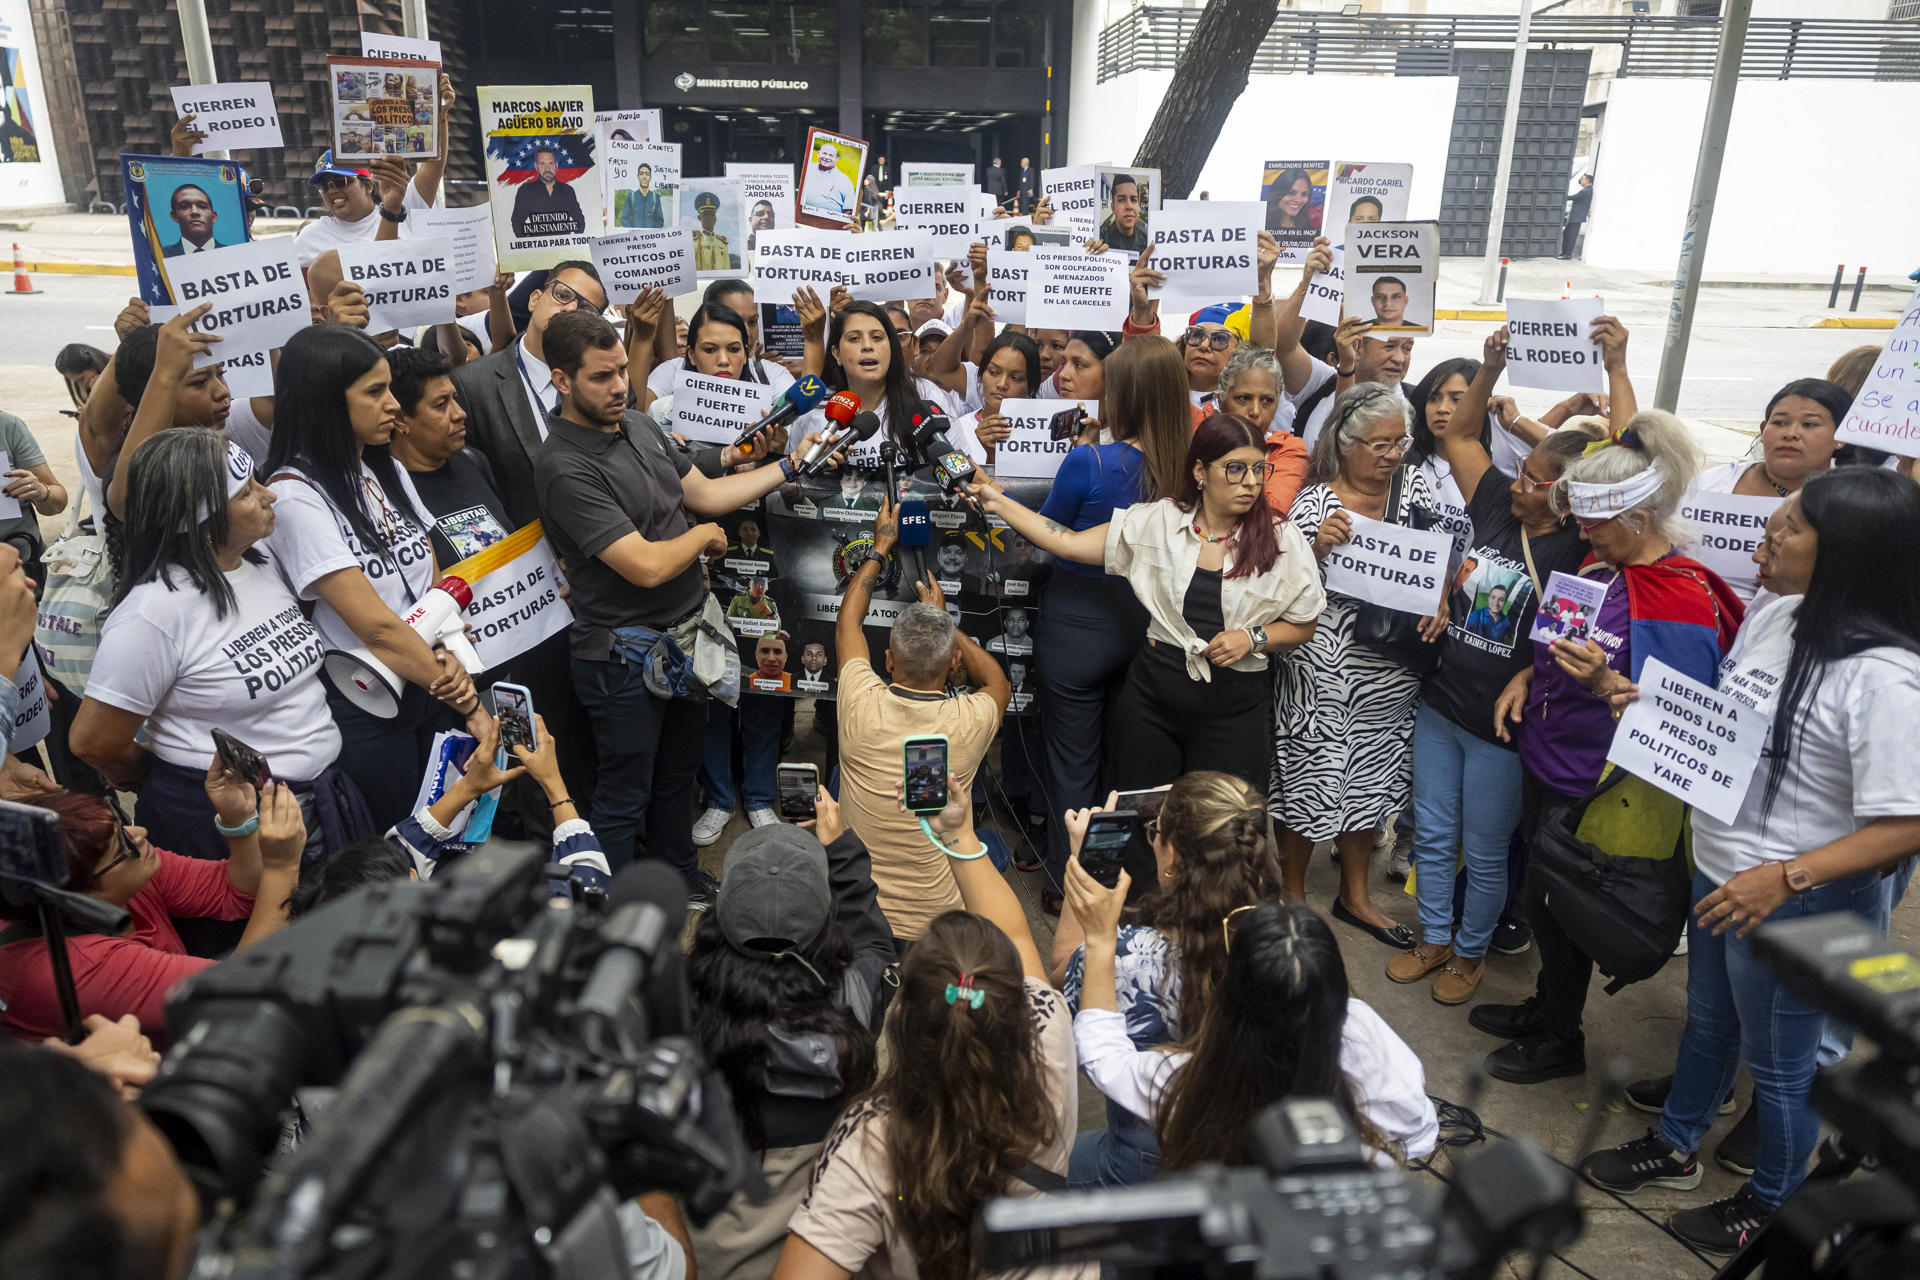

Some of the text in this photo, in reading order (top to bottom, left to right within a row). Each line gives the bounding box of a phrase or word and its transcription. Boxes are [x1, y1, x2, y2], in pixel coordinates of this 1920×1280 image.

[696, 78, 808, 89] MINISTERIO PÚBLICO
[181, 97, 256, 114] CIERREN
[492, 100, 584, 113] MARCOS JAVIER
[208, 116, 265, 132] RODEO
[498, 114, 584, 129] AGÜERO BRAVO
[647, 143, 674, 152] CADETES
[608, 157, 628, 165] FALTO
[1339, 177, 1405, 187] RICARDO CARIEL
[1350, 186, 1388, 196] LIBERTAD
[900, 202, 965, 215] CIERREN
[1061, 198, 1095, 211] RODE
[532, 212, 569, 223] DETENIDO
[523, 221, 579, 234] INJUSTAMENTE
[1155, 227, 1247, 244] BASTA DE
[1356, 230, 1419, 239] JACKSON
[510, 237, 571, 250] LIBERTAD PARA
[598, 236, 631, 246] LIBEREN
[640, 232, 666, 241] TODOS
[667, 230, 683, 238] LOS
[627, 242, 657, 251] PRESOS
[602, 249, 685, 266] POLITICOS DE
[760, 245, 842, 260] BASTA DE
[845, 247, 915, 263] CIERREN
[1036, 253, 1122, 265] LOS PRESOS POLITICOS
[1357, 244, 1421, 258] VERA
[350, 257, 446, 281] BASTA DE
[614, 263, 681, 279] COMANDOS
[1062, 264, 1108, 273] GOLPEADOS
[1149, 254, 1250, 271] TORTURAS
[181, 261, 292, 301] BASTA DE
[755, 266, 842, 283] TORTURAS
[841, 274, 860, 286] EL
[865, 268, 922, 285] RODEO
[992, 267, 1029, 281] BAST
[1053, 273, 1105, 282] AMENAZADOS
[364, 284, 450, 307] ORTURAS
[1044, 285, 1113, 296] DE MUERTE
[1056, 298, 1071, 306] LAS
[1072, 299, 1111, 307] CARCELES
[190, 293, 303, 334] TORTURAS
[1509, 321, 1578, 337] CIERREN
[1506, 347, 1523, 361] EL
[1527, 348, 1586, 365] RODEO
[685, 378, 761, 400] CIERREN EL
[696, 397, 746, 414] FUERTE
[832, 395, 855, 408] NTN24
[912, 416, 931, 436] TELEVEN
[438, 508, 488, 528] LIBERTAD
[1681, 507, 1769, 529] CIERREN
[1351, 534, 1438, 564] ASTA DE
[1701, 534, 1765, 553] RODE
[1331, 552, 1436, 590] TORTURAS
[468, 566, 546, 617] BASTA DE
[470, 589, 556, 643] TORTURAS
[871, 609, 879, 617] A
[222, 605, 302, 659] LIBEREN A TODOS
[1591, 626, 1624, 649] CAUTIVOS
[233, 647, 273, 675] LOS
[244, 639, 325, 700] POLÍTICO
[1660, 677, 1738, 722] LIBEREN A
[1731, 690, 1758, 709] PRESOS
[1749, 683, 1772, 699] TODOS
[1654, 695, 1737, 743] TODOS LOS
[1659, 720, 1718, 757] PRESOS
[1629, 729, 1734, 789] POLITICOS DE
[1653, 762, 1693, 791] YARE
